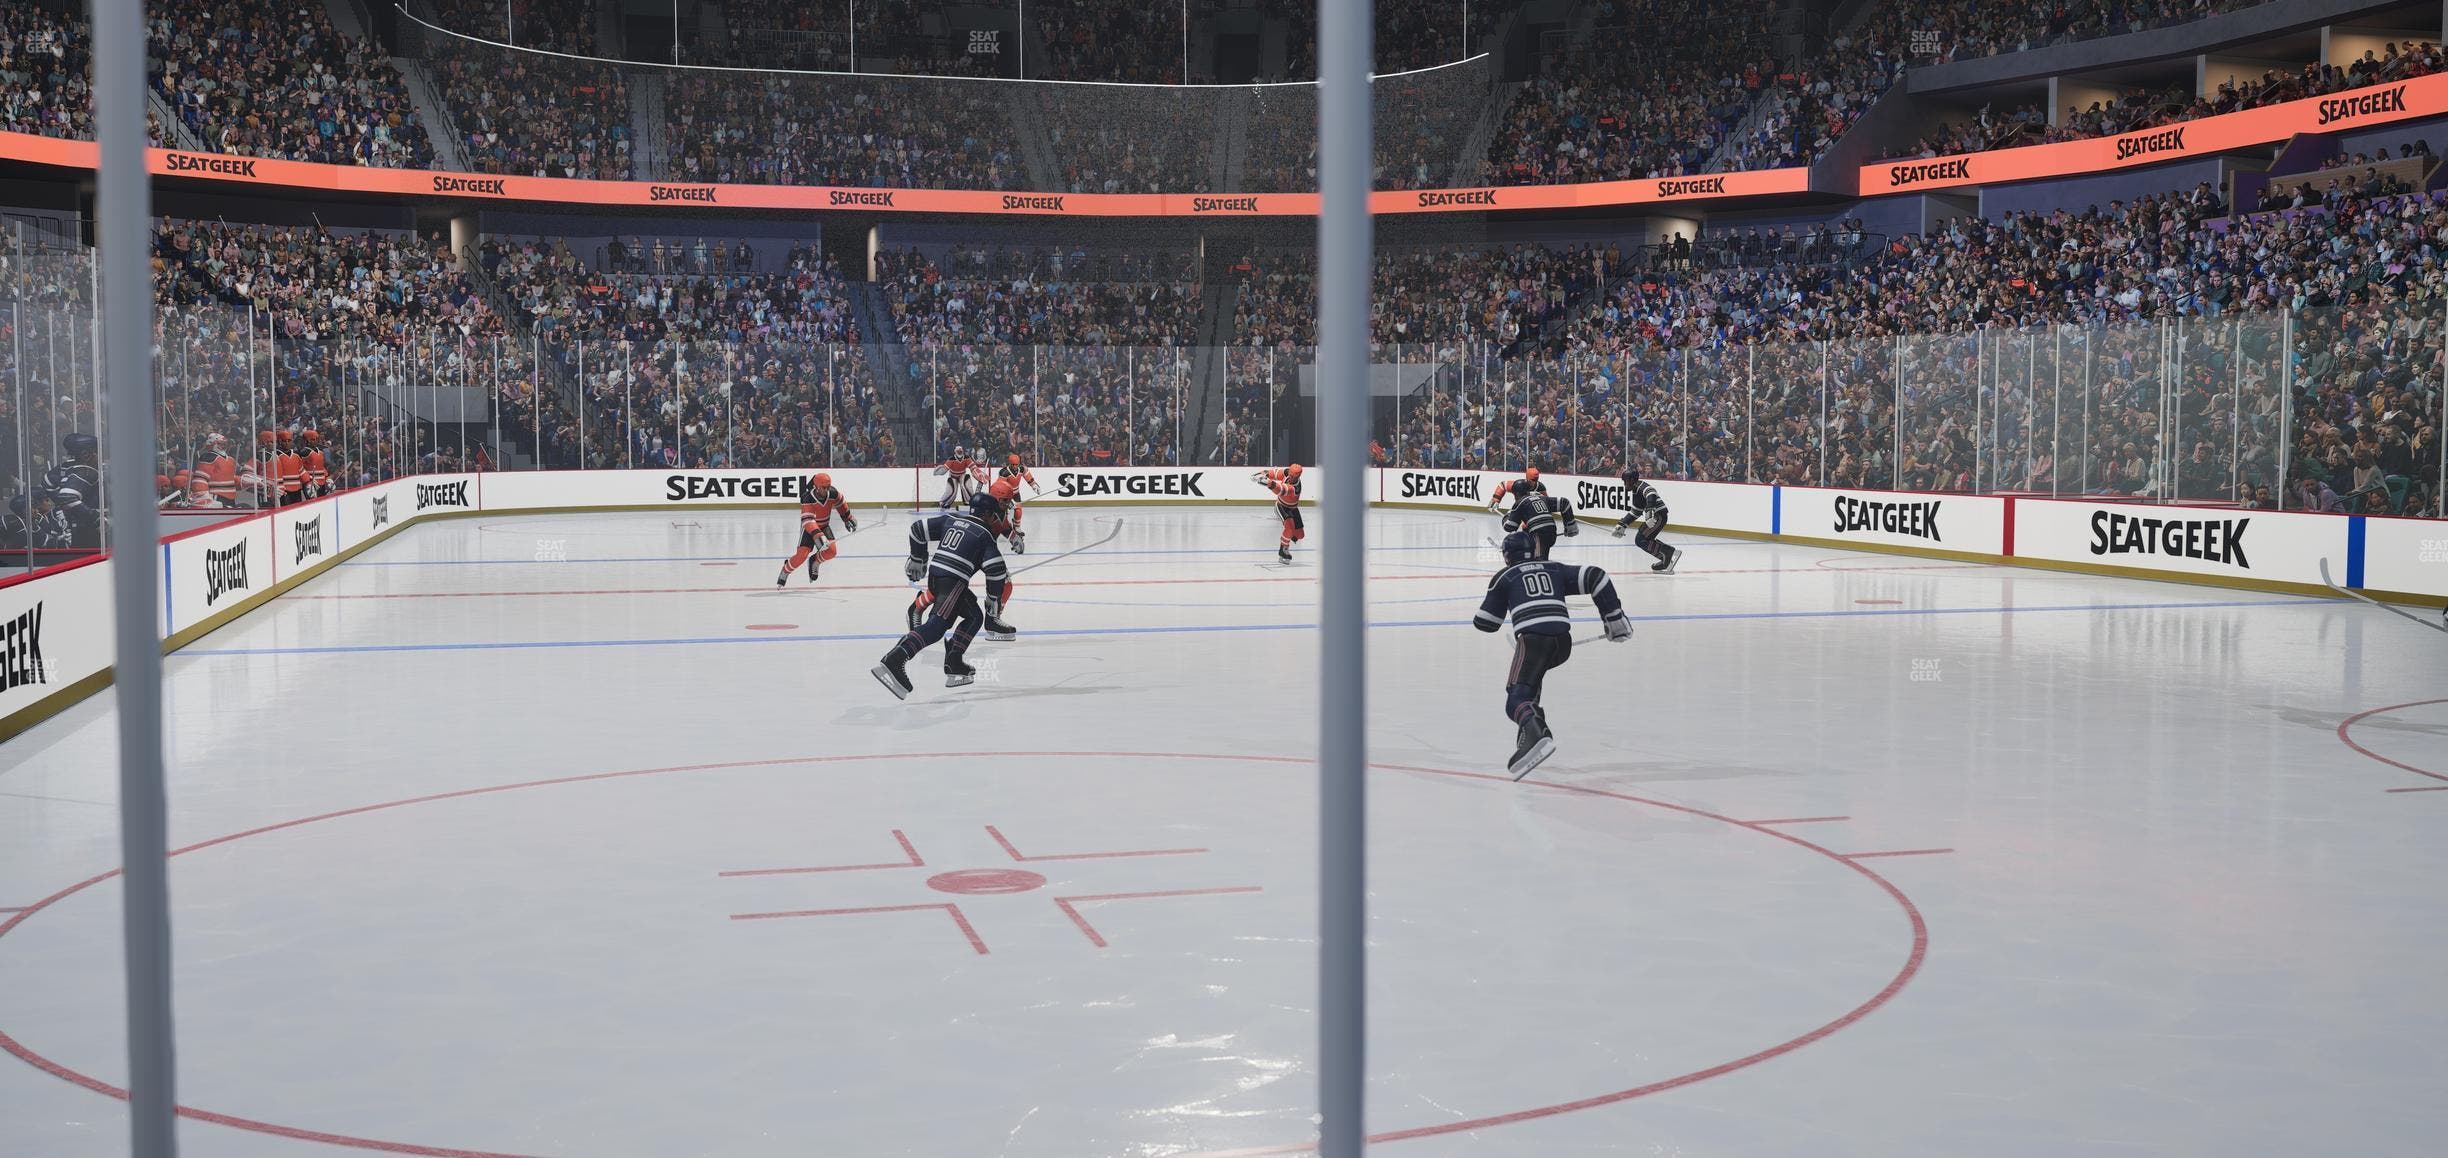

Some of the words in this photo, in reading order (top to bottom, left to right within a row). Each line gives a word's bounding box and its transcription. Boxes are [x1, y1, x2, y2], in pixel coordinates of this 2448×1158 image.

[2318, 84, 2407, 126] SEATGEEK
[2116, 127, 2185, 160] SEATGEEK
[166, 152, 257, 178] SEATGEEK
[1890, 157, 1970, 186] SEATGEEK
[433, 175, 505, 195] SEATGEEK
[651, 185, 717, 202] SEATGEEK
[1418, 189, 1497, 207] SEATGEEK
[1658, 176, 1725, 197] SEATGEEK
[830, 191, 894, 206] SEATGEEK
[1003, 195, 1064, 210] SEATGEEK
[1193, 197, 1258, 212] SEATGEEK
[416, 480, 469, 510] SEATGEEK
[1058, 472, 1205, 498] SEATGEEK
[1402, 473, 1481, 502] SEATGEEK
[1577, 480, 1631, 511] SEATGEE
[1834, 495, 1942, 542] SEATGEEK
[295, 514, 322, 566] SEATGEEK
[940, 527, 966, 551] 00
[2091, 510, 2251, 570] SEATGEEK
[206, 537, 249, 607] SEATGEEK
[1522, 571, 1555, 597] 00
